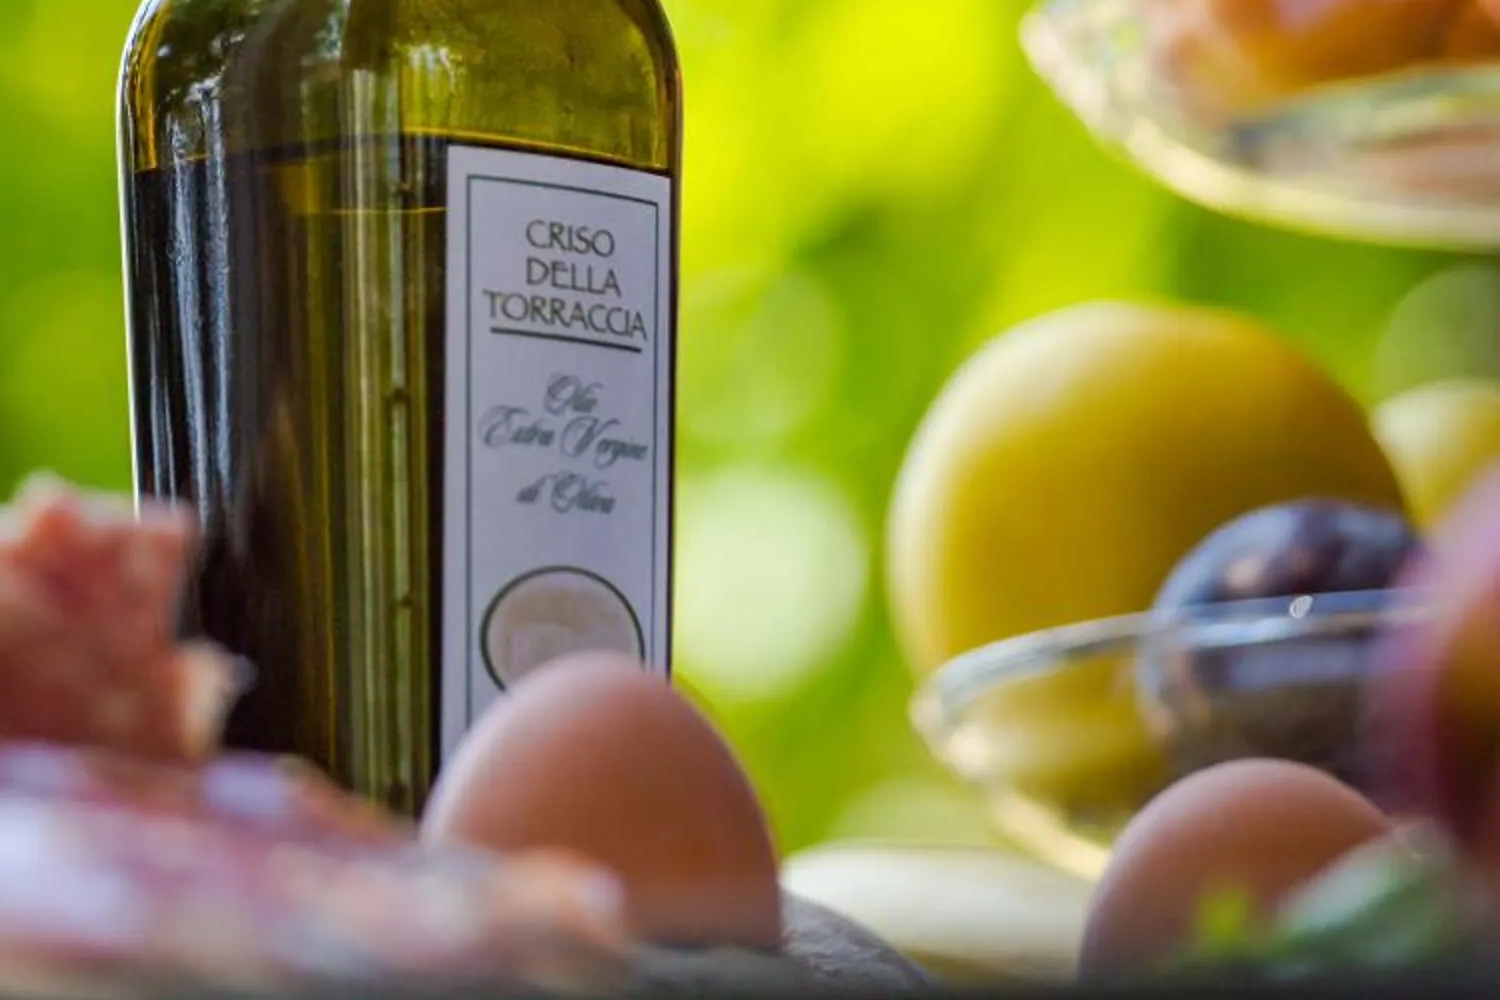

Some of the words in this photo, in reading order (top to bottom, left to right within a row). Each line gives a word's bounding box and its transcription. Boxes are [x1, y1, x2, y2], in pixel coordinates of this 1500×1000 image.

[525, 220, 615, 258] CRISO
[526, 256, 622, 298] DELLA
[482, 288, 648, 341] TORRACCIA
